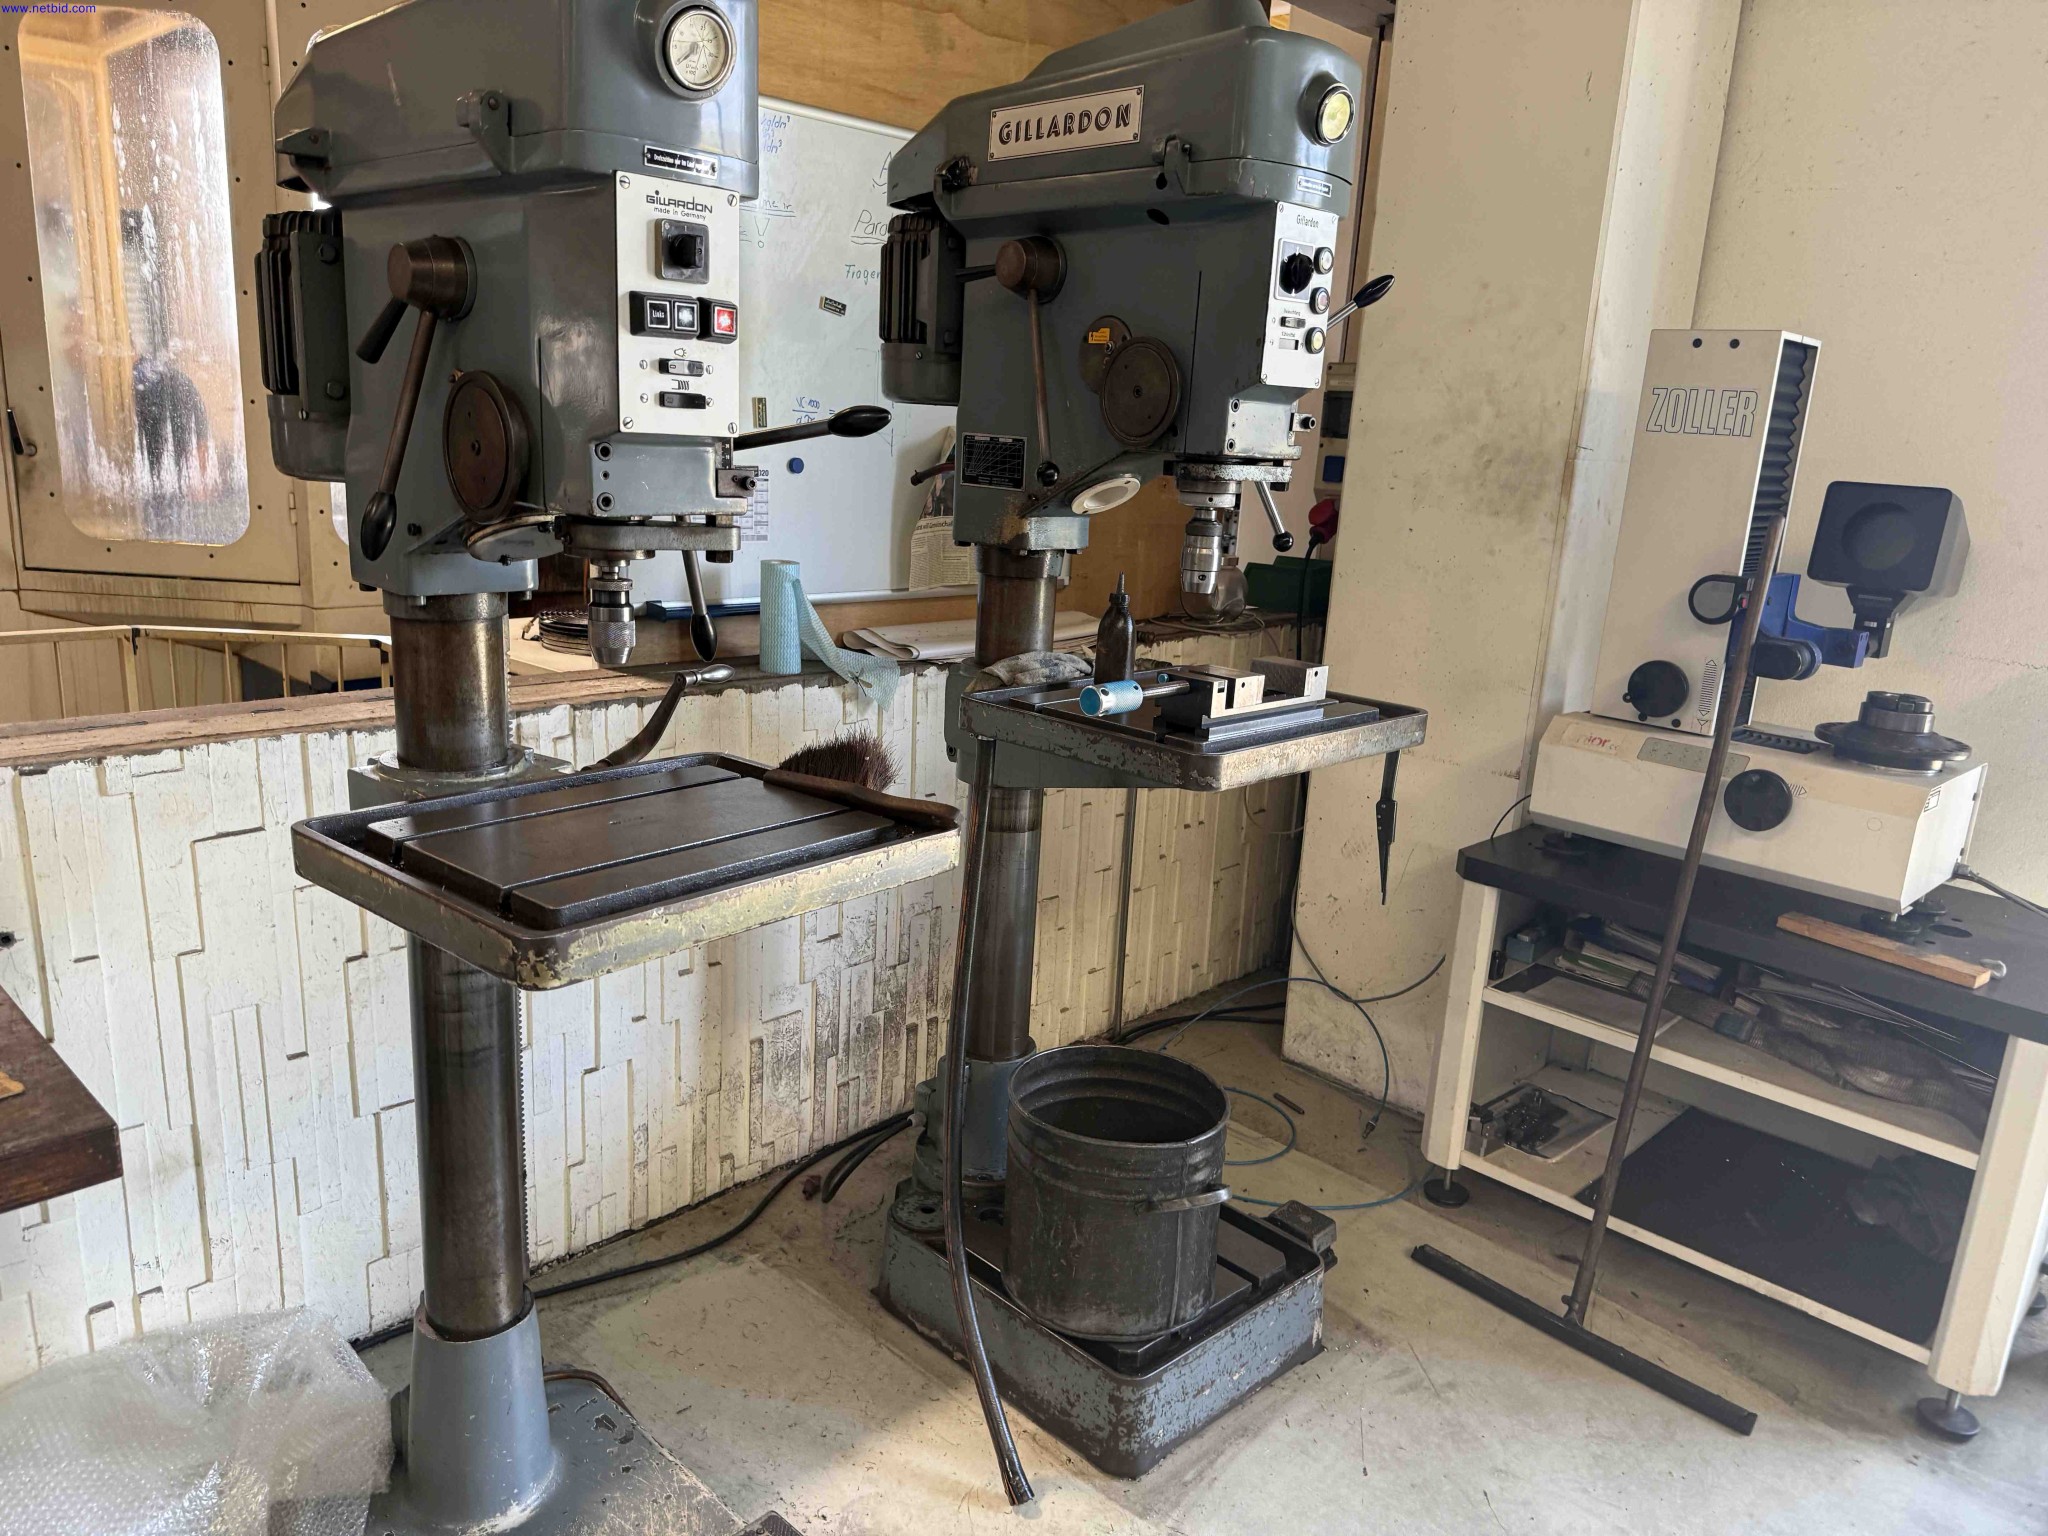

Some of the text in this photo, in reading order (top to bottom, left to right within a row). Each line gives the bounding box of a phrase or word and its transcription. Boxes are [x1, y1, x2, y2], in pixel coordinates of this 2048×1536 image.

[998, 103, 1132, 145] GILLARDON
[653, 207, 707, 221] made in Germany
[652, 309, 665, 319] Links
[1645, 387, 1758, 438] ZOLLER
